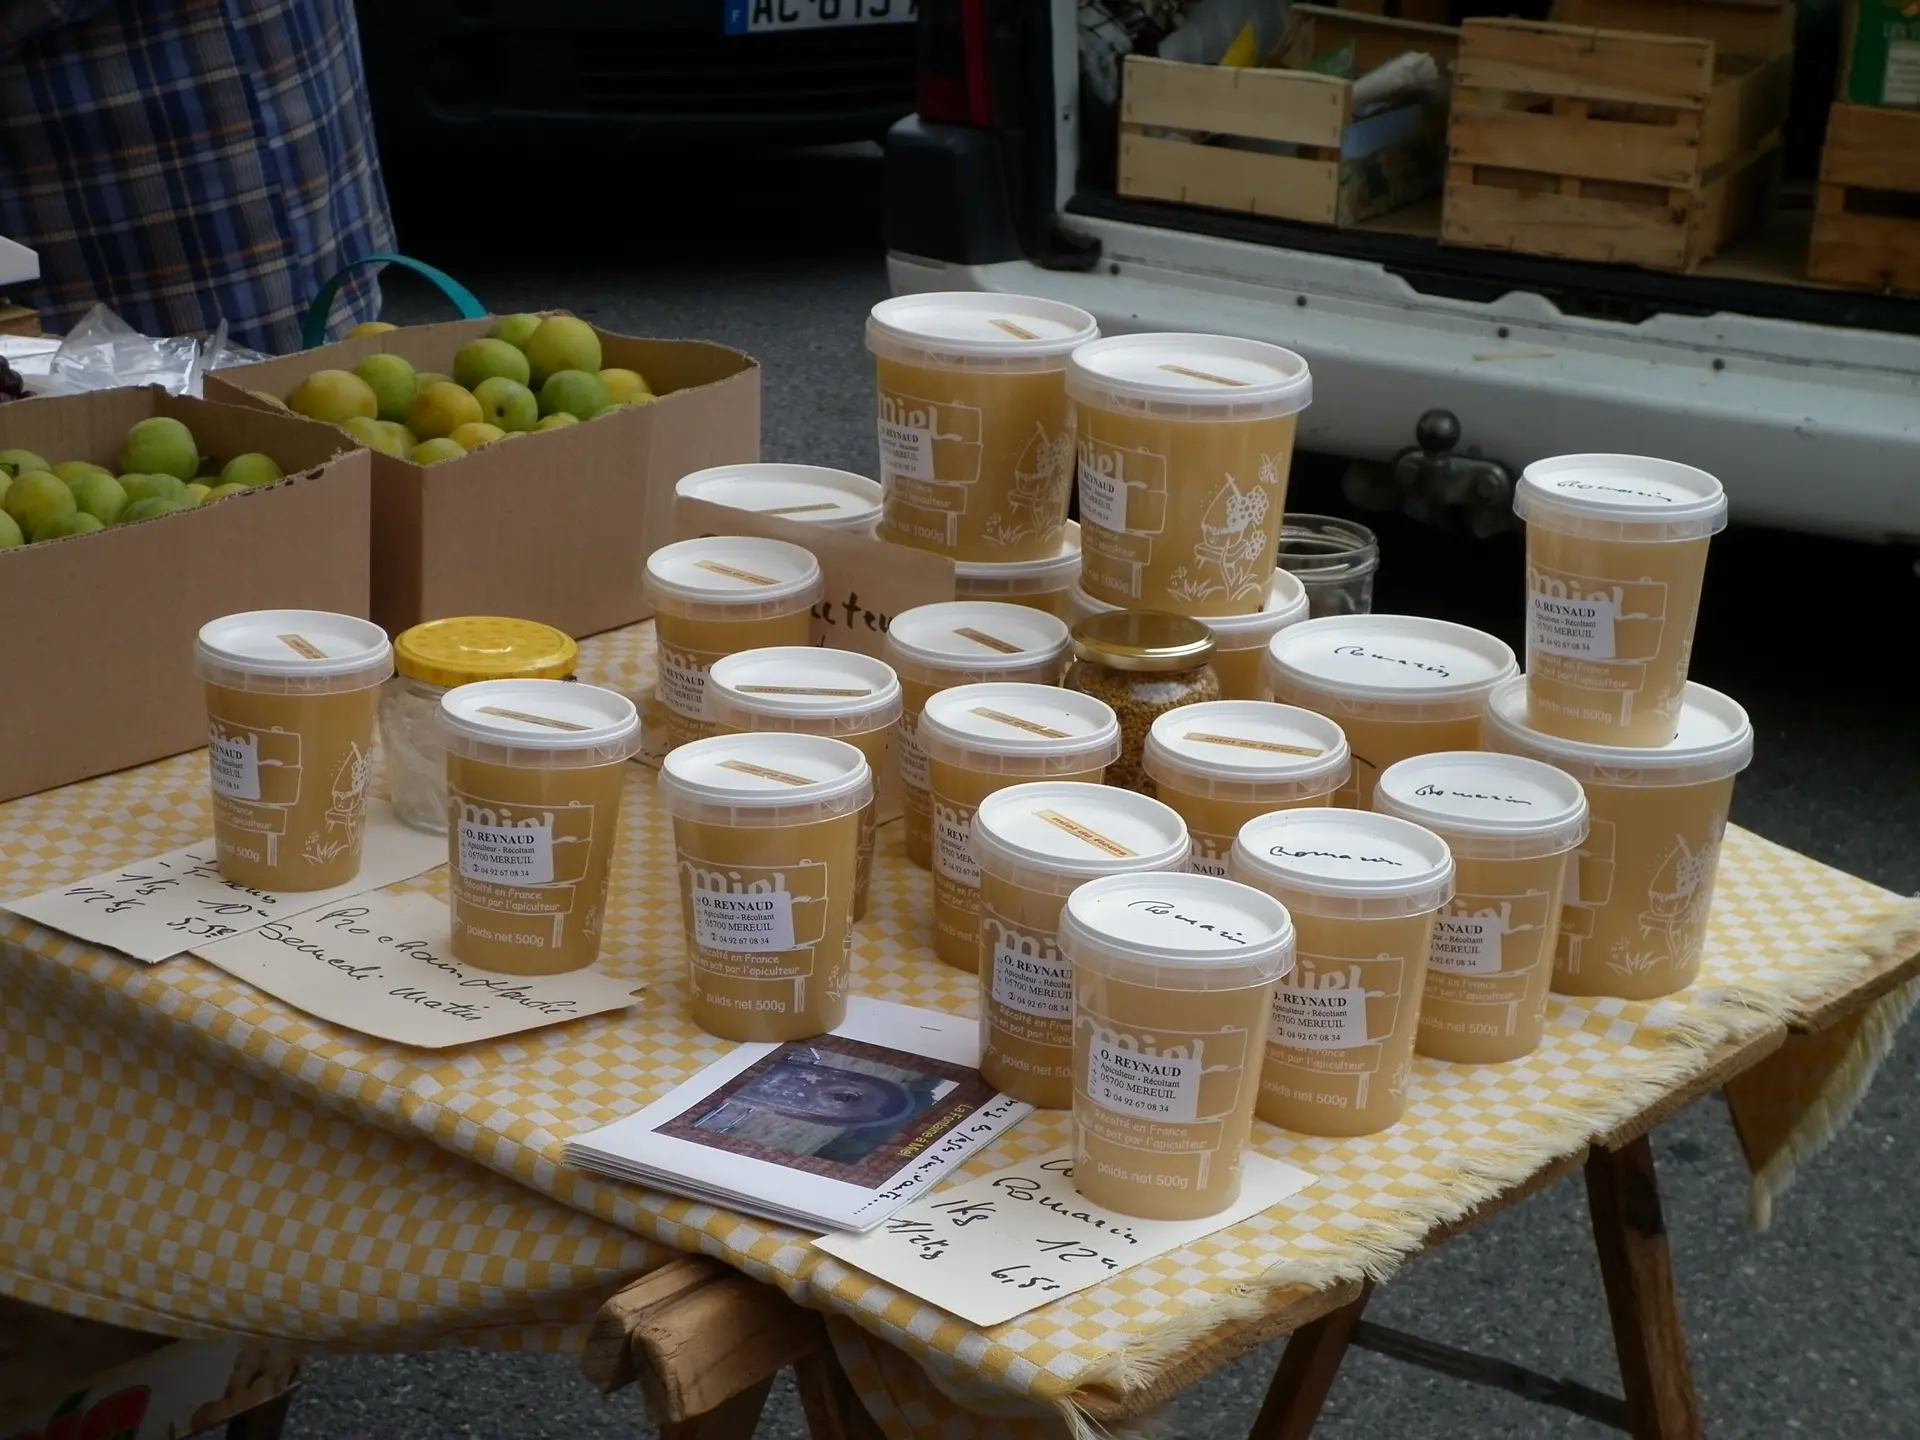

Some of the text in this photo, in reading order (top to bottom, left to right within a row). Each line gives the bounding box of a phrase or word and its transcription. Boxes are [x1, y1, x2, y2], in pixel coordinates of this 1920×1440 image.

[1543, 602, 1596, 618] REYNAUD
[1554, 627, 1595, 639] MEREUIL
[1582, 708, 1612, 724] 500g
[466, 829, 535, 845] O. REYNAUD
[1052, 816, 1127, 857] miel de fleurs
[236, 845, 261, 863] 500g
[468, 841, 535, 854] Apiculteur Récoltant
[1270, 845, 1402, 866] Romarin
[468, 850, 533, 864] 05700 MEREUIL
[1191, 863, 1225, 876] NAUD
[495, 887, 506, 896] en
[508, 888, 542, 899] France
[488, 897, 503, 908] par
[505, 899, 560, 911] l'apiculteur
[702, 897, 773, 911] O. REYNAUD
[703, 909, 775, 921] Apiculteur Récoltant
[1127, 900, 1247, 945] Romarin
[704, 919, 774, 932] 05700 MEREUIL
[1435, 921, 1483, 934] YNAUD
[466, 924, 544, 947] poids net 500g
[739, 937, 748, 945] 67
[749, 937, 758, 945] 08
[1449, 935, 1483, 944] Récoltant
[1436, 943, 1481, 954] MEREUIL
[731, 953, 779, 964] en France
[709, 960, 800, 977] pot par l'apiculteur
[1004, 954, 1072, 980] O. REYNAU
[1004, 967, 1037, 984] Apiculteur
[1004, 977, 1027, 992] 05700
[1462, 979, 1497, 990] France
[706, 992, 786, 1013] poids net 500g
[1017, 996, 1069, 1012] 04 92 67 08 34
[1283, 993, 1347, 1007] REYNAUD
[1000, 1005, 1046, 1028] Récolté en
[1272, 1012, 1346, 1028] 05700 MEREUIL
[1312, 1009, 1348, 1017] Récoltant
[1010, 1023, 1026, 1036] pot
[1026, 1029, 1044, 1041] par
[1286, 1030, 1296, 1039] 04
[1297, 1032, 1307, 1040] 92
[1308, 1032, 1318, 1041] 67
[1319, 1034, 1329, 1042] 08
[1446, 1022, 1498, 1036] net 500g
[1001, 1053, 1052, 1076] poids net
[1101, 1049, 1112, 1063] O.
[1114, 1055, 1182, 1078] REYNAUD
[1287, 1053, 1366, 1070] par l'apiculteur
[1100, 1062, 1180, 1089] Apiculteur Récoltant
[1100, 1073, 1125, 1090] 05700
[1126, 1082, 1177, 1100] MEREUIL
[1263, 1078, 1348, 1108] poids net 500g
[957, 1103, 974, 1115] La
[1113, 1094, 1169, 1113] 04 92 67 08 34
[921, 1113, 963, 1139] Fontaine
[1095, 1109, 1188, 1137] Récolté en France
[1106, 1127, 1208, 1150] pot par l'apiculteur
[898, 1140, 919, 1159] Miel
[1097, 1161, 1189, 1189] poids net 500g
